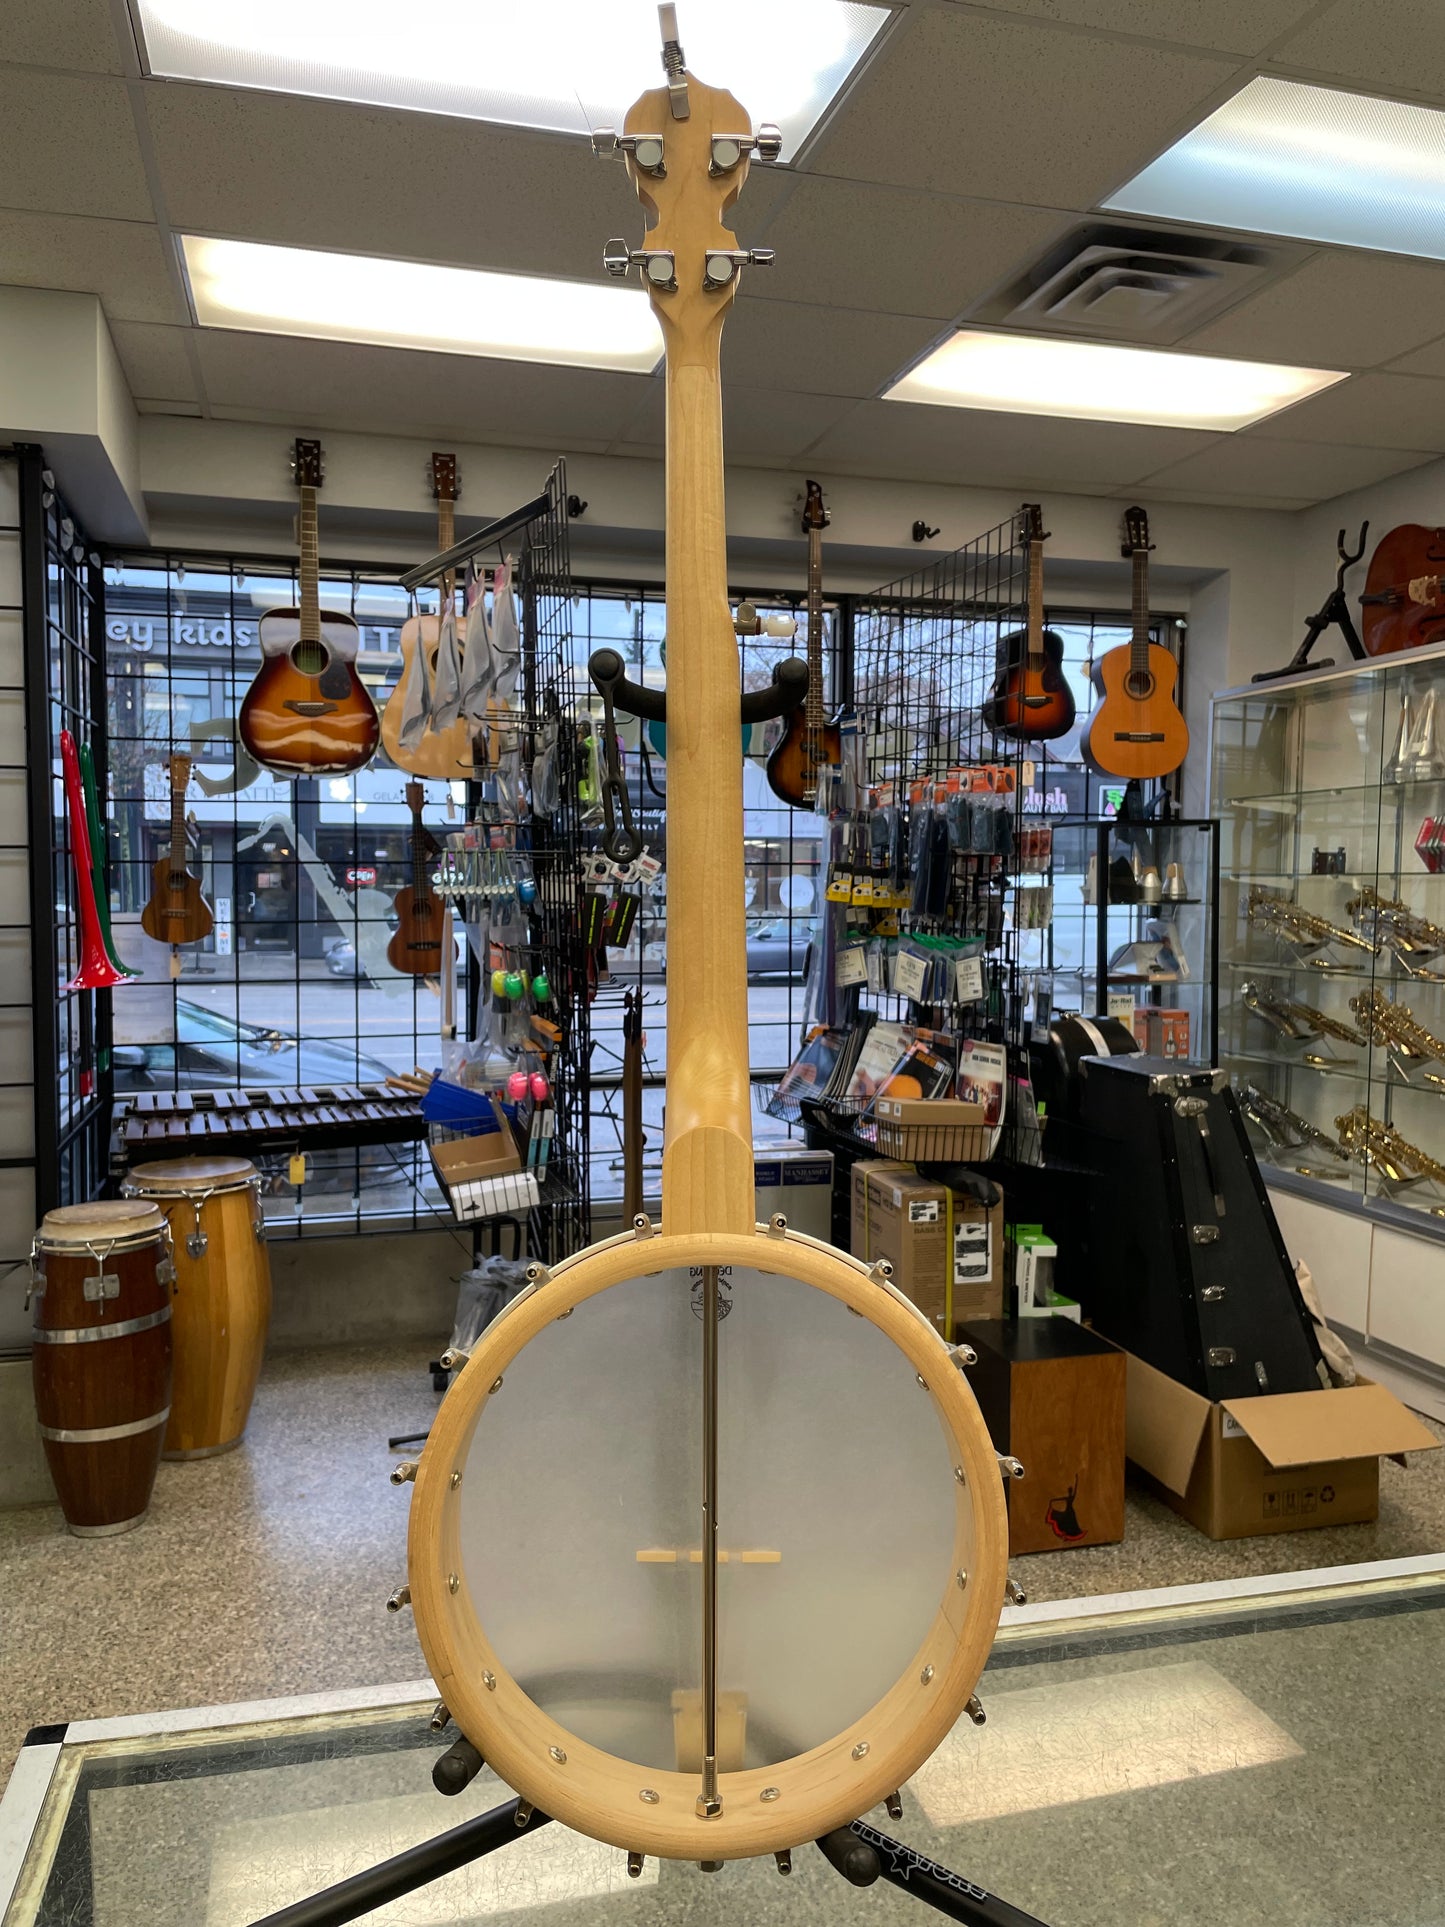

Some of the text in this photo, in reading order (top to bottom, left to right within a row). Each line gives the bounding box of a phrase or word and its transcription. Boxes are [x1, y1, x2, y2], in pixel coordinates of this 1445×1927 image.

[173, 610, 252, 648] kids
[1023, 787, 1068, 805] lush
[1050, 804, 1068, 813] BAR
